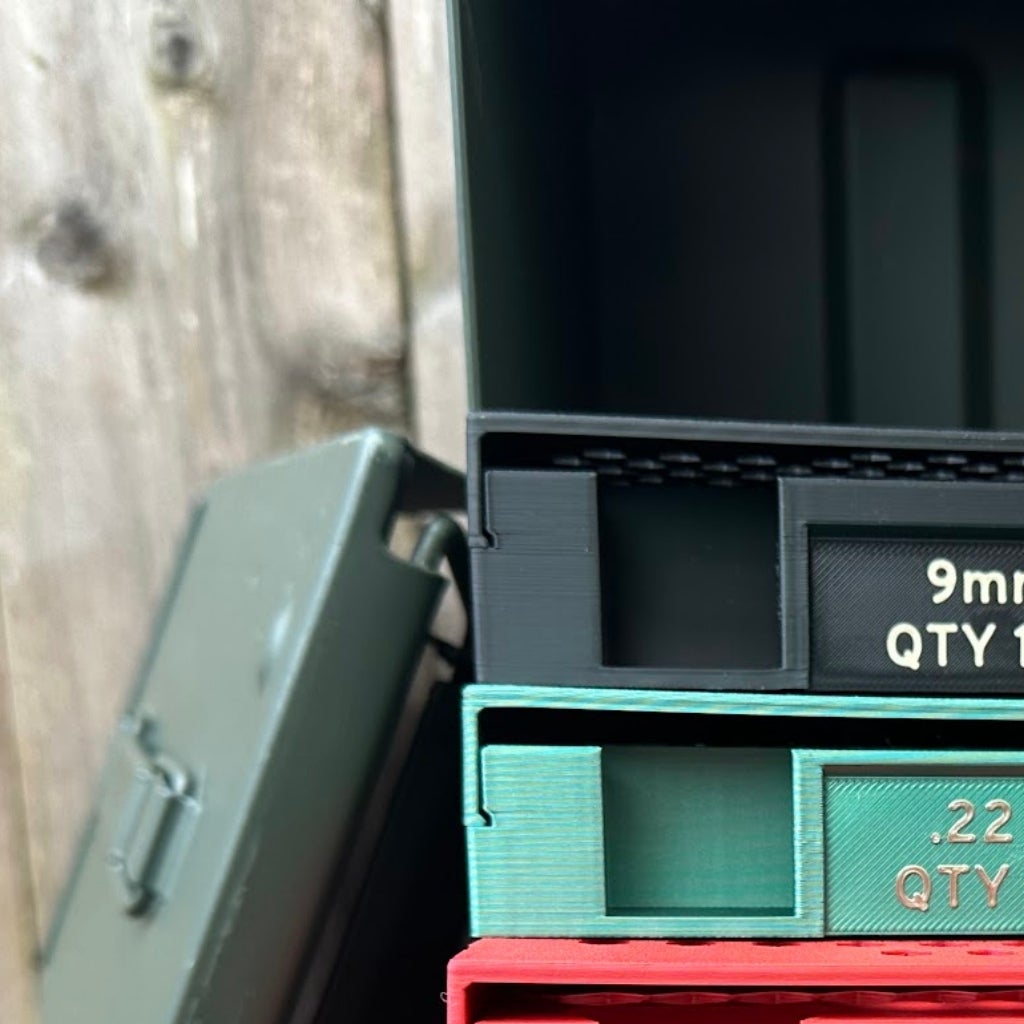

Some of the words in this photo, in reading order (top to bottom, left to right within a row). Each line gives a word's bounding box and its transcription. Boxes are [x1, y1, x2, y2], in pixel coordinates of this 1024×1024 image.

[886, 622, 997, 671] QTY
[930, 798, 1014, 845] .22
[895, 864, 1010, 912] QTY
